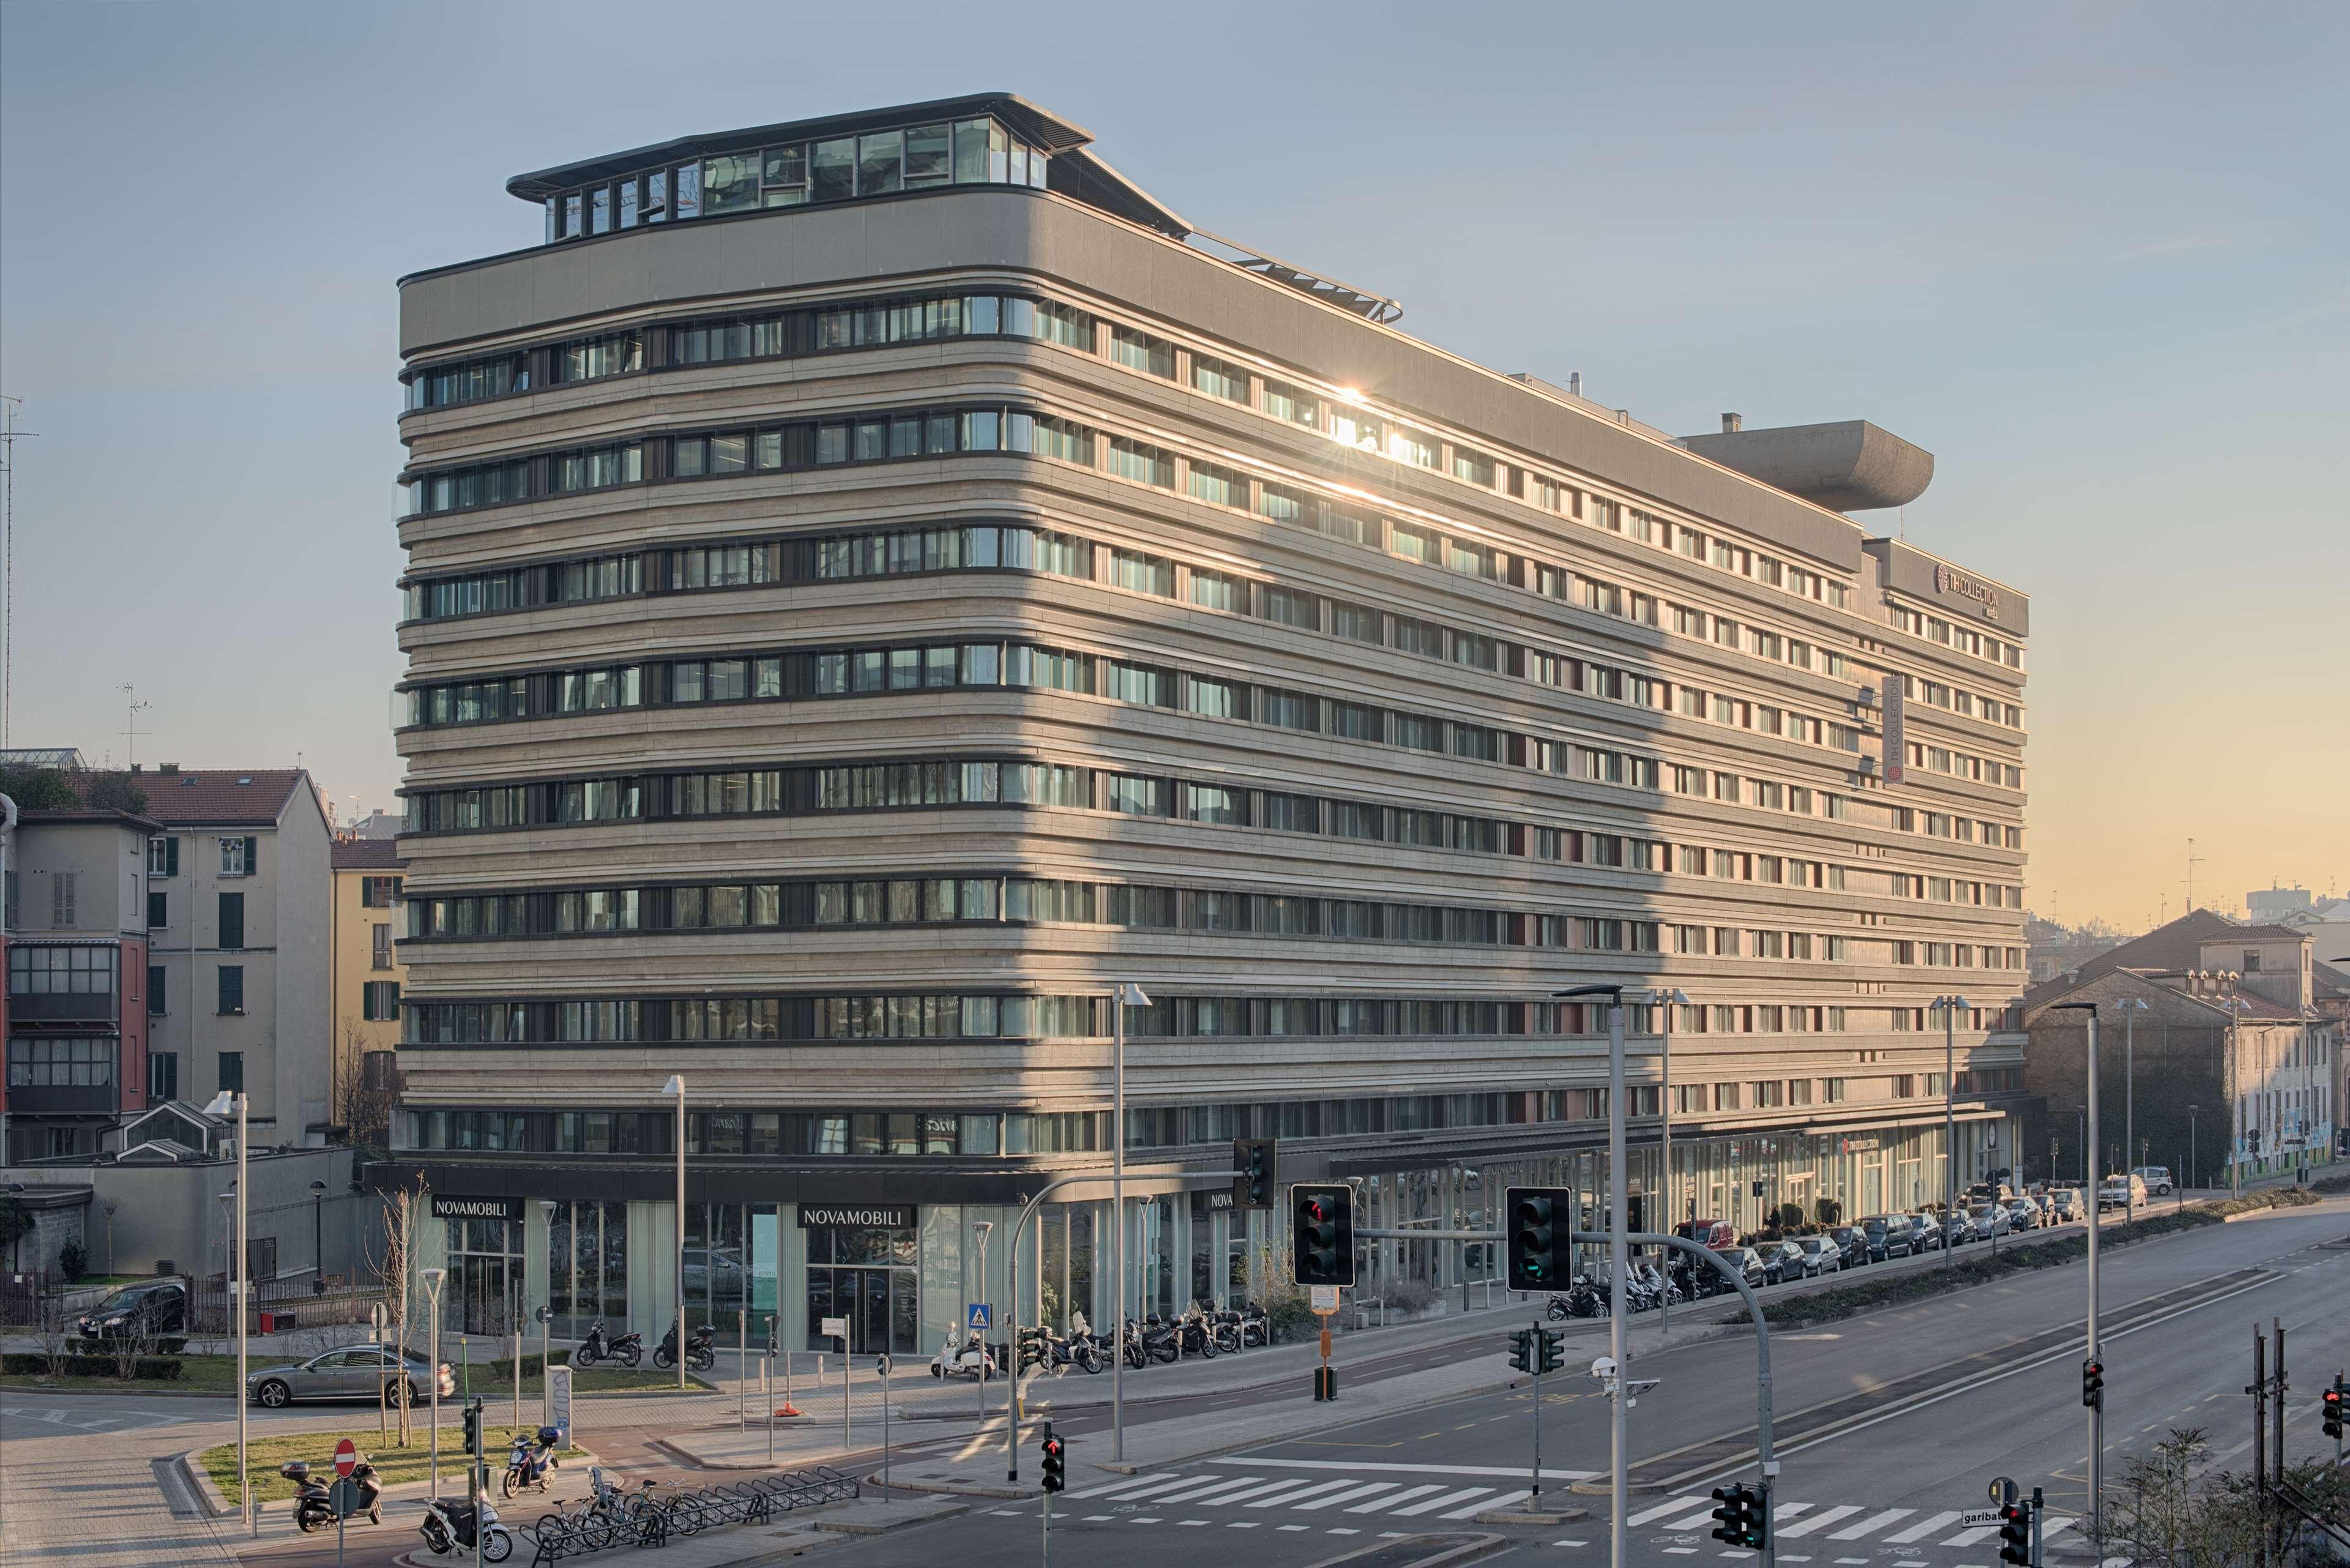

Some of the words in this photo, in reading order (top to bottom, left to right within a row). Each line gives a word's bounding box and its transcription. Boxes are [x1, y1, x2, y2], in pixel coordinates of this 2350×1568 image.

[1960, 577, 1998, 608] COLLECTION
[1890, 679, 1899, 745] COLLECTION
[1856, 1138, 1879, 1150] COLLECTION
[1212, 1193, 1233, 1208] NOVA
[436, 1201, 506, 1216] NOVAMOBILI
[805, 1210, 901, 1225] NOVAMOBILI
[1964, 1511, 2005, 1524] garibal
